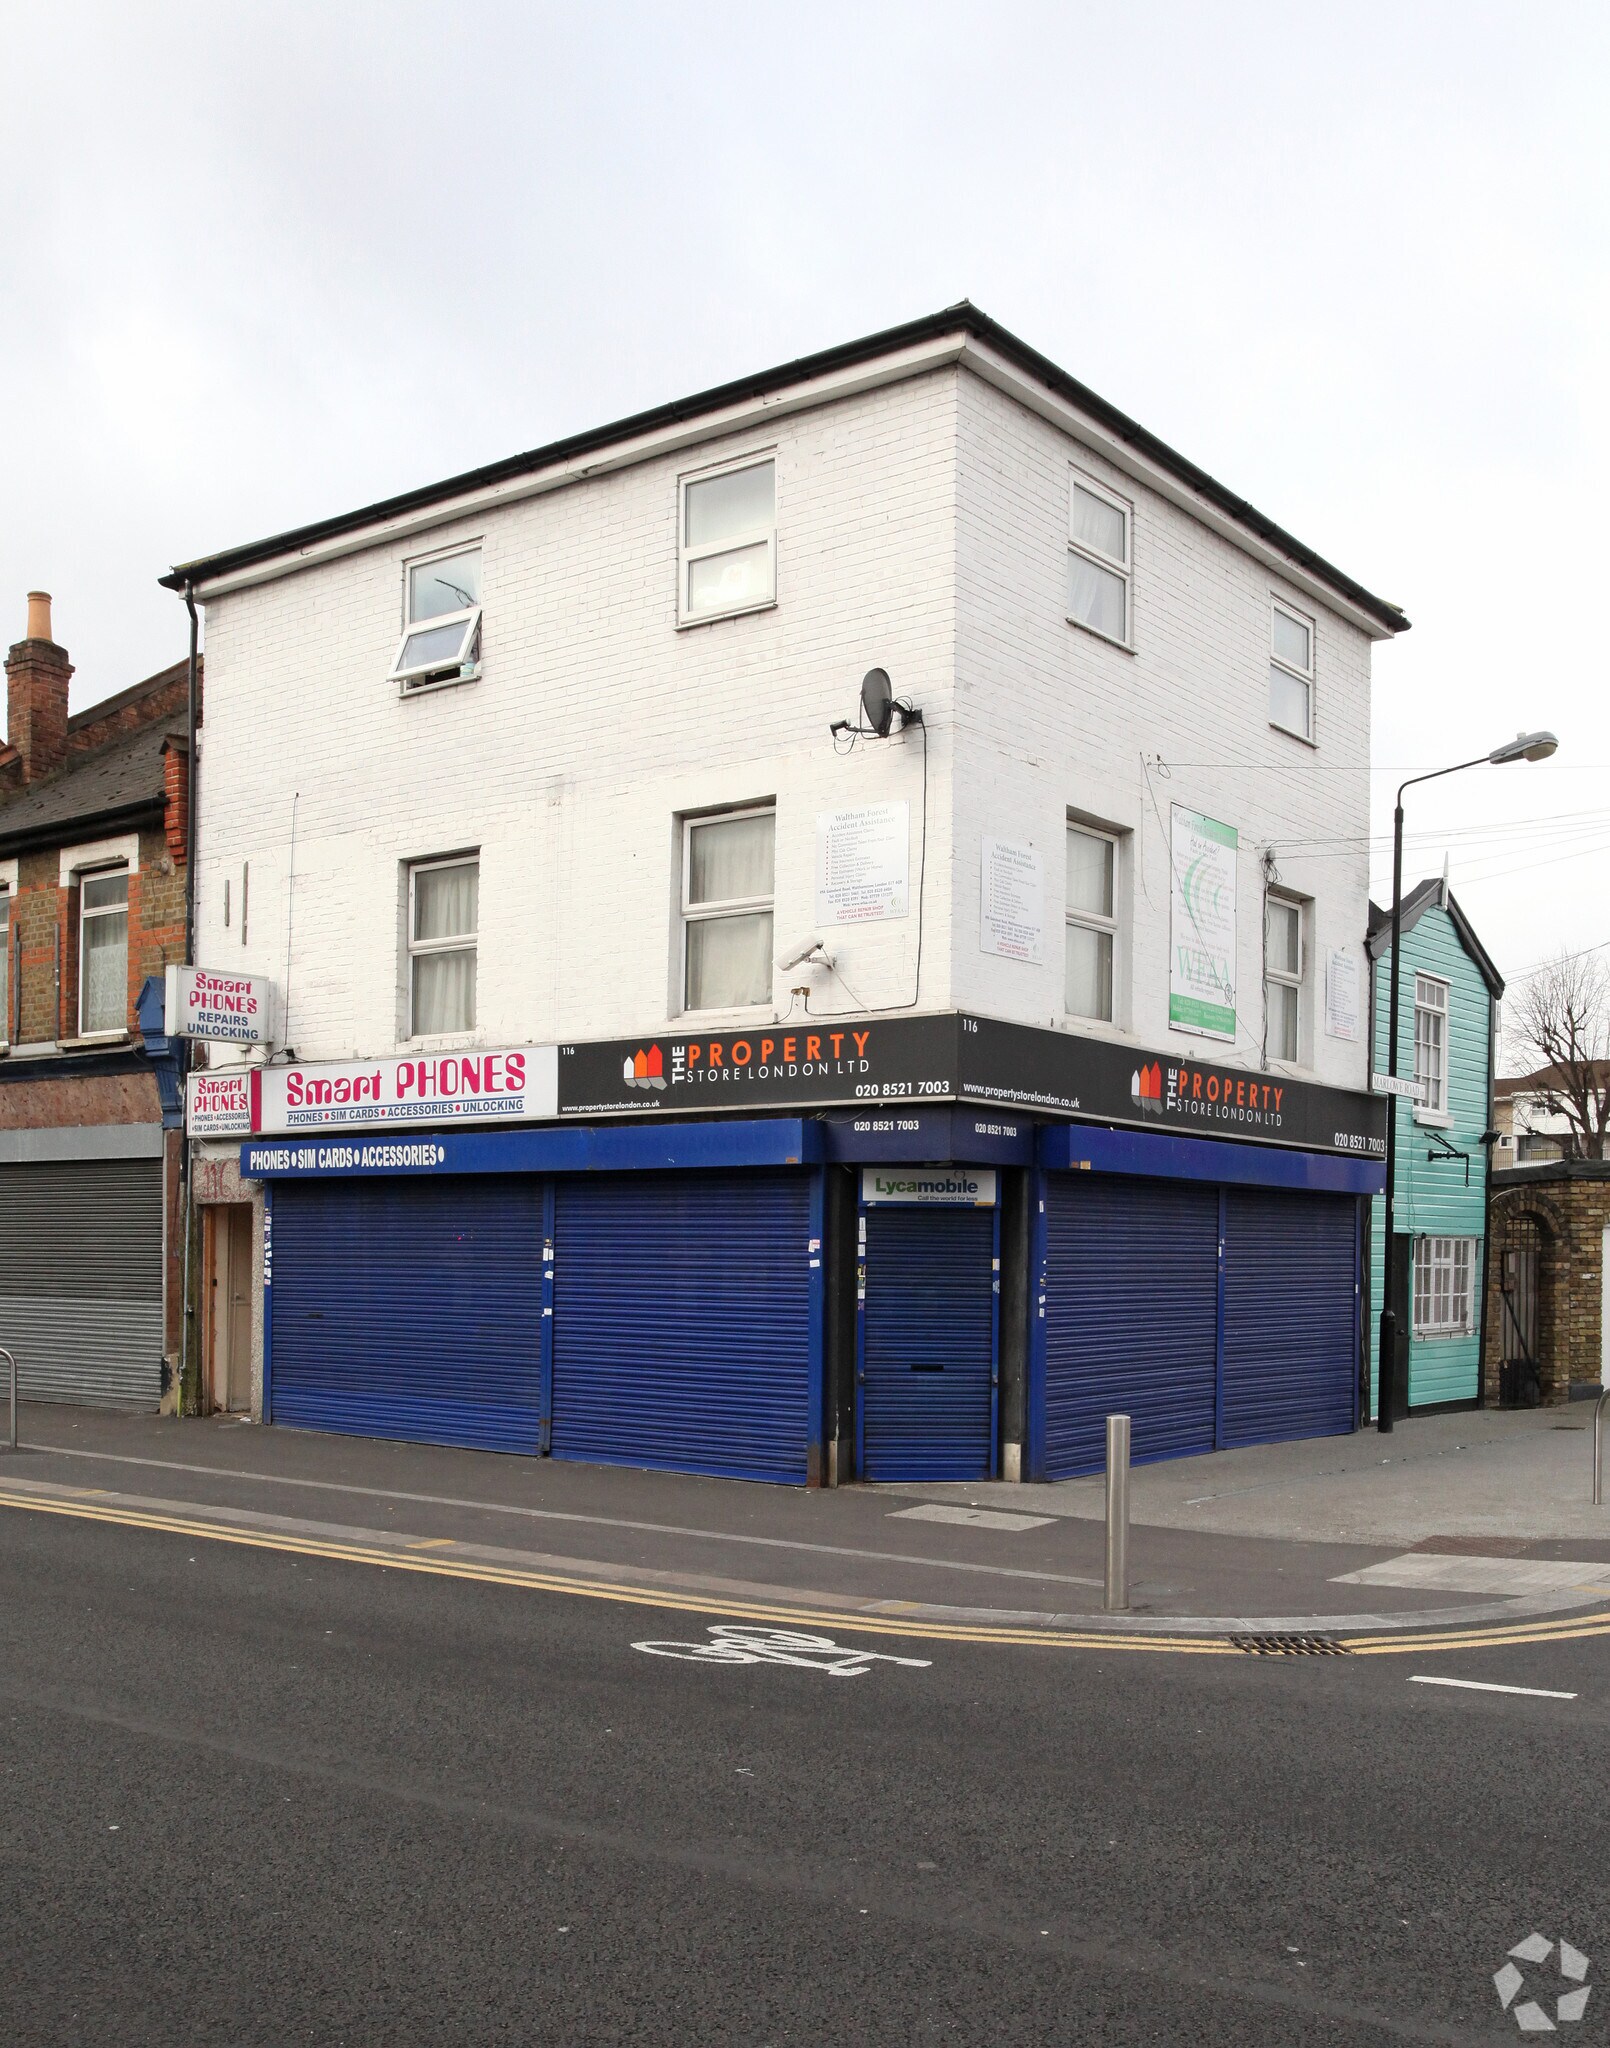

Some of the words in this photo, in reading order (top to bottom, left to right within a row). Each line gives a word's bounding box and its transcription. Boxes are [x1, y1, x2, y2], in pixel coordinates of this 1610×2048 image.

[828, 822, 858, 832] Accident
[860, 817, 895, 827] Assistance
[835, 812, 865, 822] Waltham
[867, 808, 888, 817] Forest
[196, 972, 252, 994] Smart
[190, 991, 257, 1014] PHONES
[198, 1012, 248, 1026] REPAIRS
[963, 1019, 978, 1033] 116
[187, 1023, 258, 1039] UNLOCKING
[562, 1047, 575, 1056] 116
[688, 1031, 870, 1068] PROPERTY
[672, 1046, 685, 1084] THE
[687, 1067, 740, 1083] STORE
[748, 1062, 828, 1079] LONDON
[837, 1060, 870, 1075] LTD
[198, 1077, 242, 1094] Smart
[287, 1069, 382, 1106] Smart
[397, 1053, 525, 1099] PHONES
[855, 1084, 879, 1097] 020
[882, 1082, 912, 1095] 8521
[918, 1081, 950, 1094] 7003
[1167, 1068, 1178, 1110] THE
[1373, 1075, 1404, 1092] MARLOWE
[1404, 1083, 1419, 1096] ROAD
[963, 1083, 1080, 1108] www.propertystorelondon.co.uk
[1178, 1070, 1283, 1112] PROPERTY
[194, 1093, 247, 1112] PHONES
[288, 1112, 323, 1123] PHONES
[330, 1110, 347, 1121] SIM
[349, 1108, 380, 1120] CARDS
[387, 1103, 454, 1117] ACCESSORIES
[463, 1099, 524, 1113] UNLOCKING
[562, 1100, 660, 1112] www.propertystorelondon.co.uk
[195, 1114, 213, 1122] PHONES
[215, 1112, 249, 1121] ACCESSORIES
[1177, 1098, 1212, 1117] STORE
[1216, 1105, 1261, 1124] LONDON
[1265, 1113, 1282, 1127] LTD
[194, 1124, 203, 1132] SIM
[203, 1123, 219, 1131] CARDS
[221, 1122, 250, 1131] UNLOCKING
[854, 1121, 870, 1131] 020
[872, 1121, 894, 1131] 8521
[897, 1120, 919, 1130] 7003
[975, 1123, 987, 1133] 020
[987, 1124, 1002, 1135] 8521
[1003, 1126, 1017, 1136] 7003
[1334, 1132, 1348, 1147] 020
[1349, 1135, 1366, 1149] 8521
[1368, 1138, 1385, 1152] 7003
[250, 1150, 290, 1170] PHONES
[298, 1148, 316, 1169] SIM
[318, 1147, 353, 1168] CARDS
[361, 1144, 437, 1167] ACCESSORIES
[875, 1178, 978, 1195] Lycamobile
